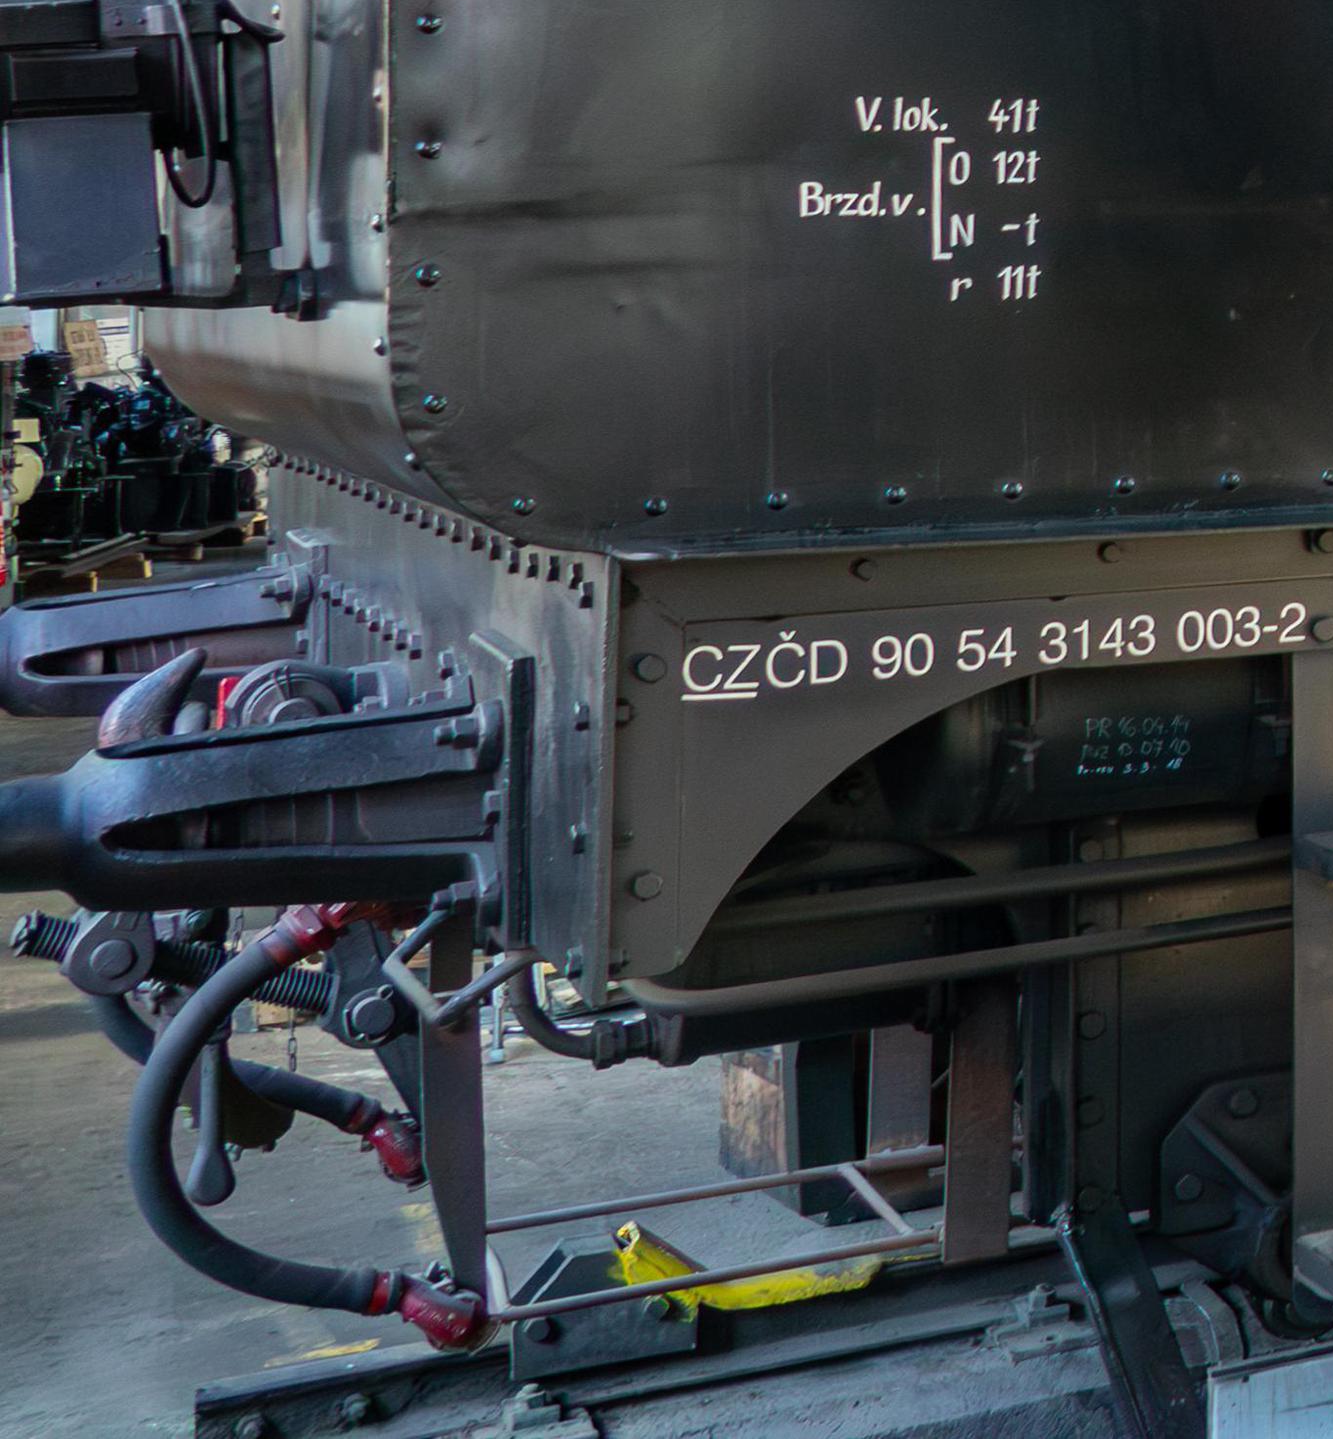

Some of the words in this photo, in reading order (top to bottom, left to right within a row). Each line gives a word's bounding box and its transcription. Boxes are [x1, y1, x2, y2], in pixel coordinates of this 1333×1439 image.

[855, 96, 882, 131] V.
[893, 96, 949, 131] lok.
[988, 98, 1040, 133] 41t
[993, 150, 1040, 184] 12t
[950, 213, 975, 247] N
[997, 264, 1042, 300] 11t
[872, 633, 934, 681] 90
[956, 626, 1017, 673] 54
[1038, 615, 1156, 665] 3143
[1177, 603, 1307, 654] 003-2
